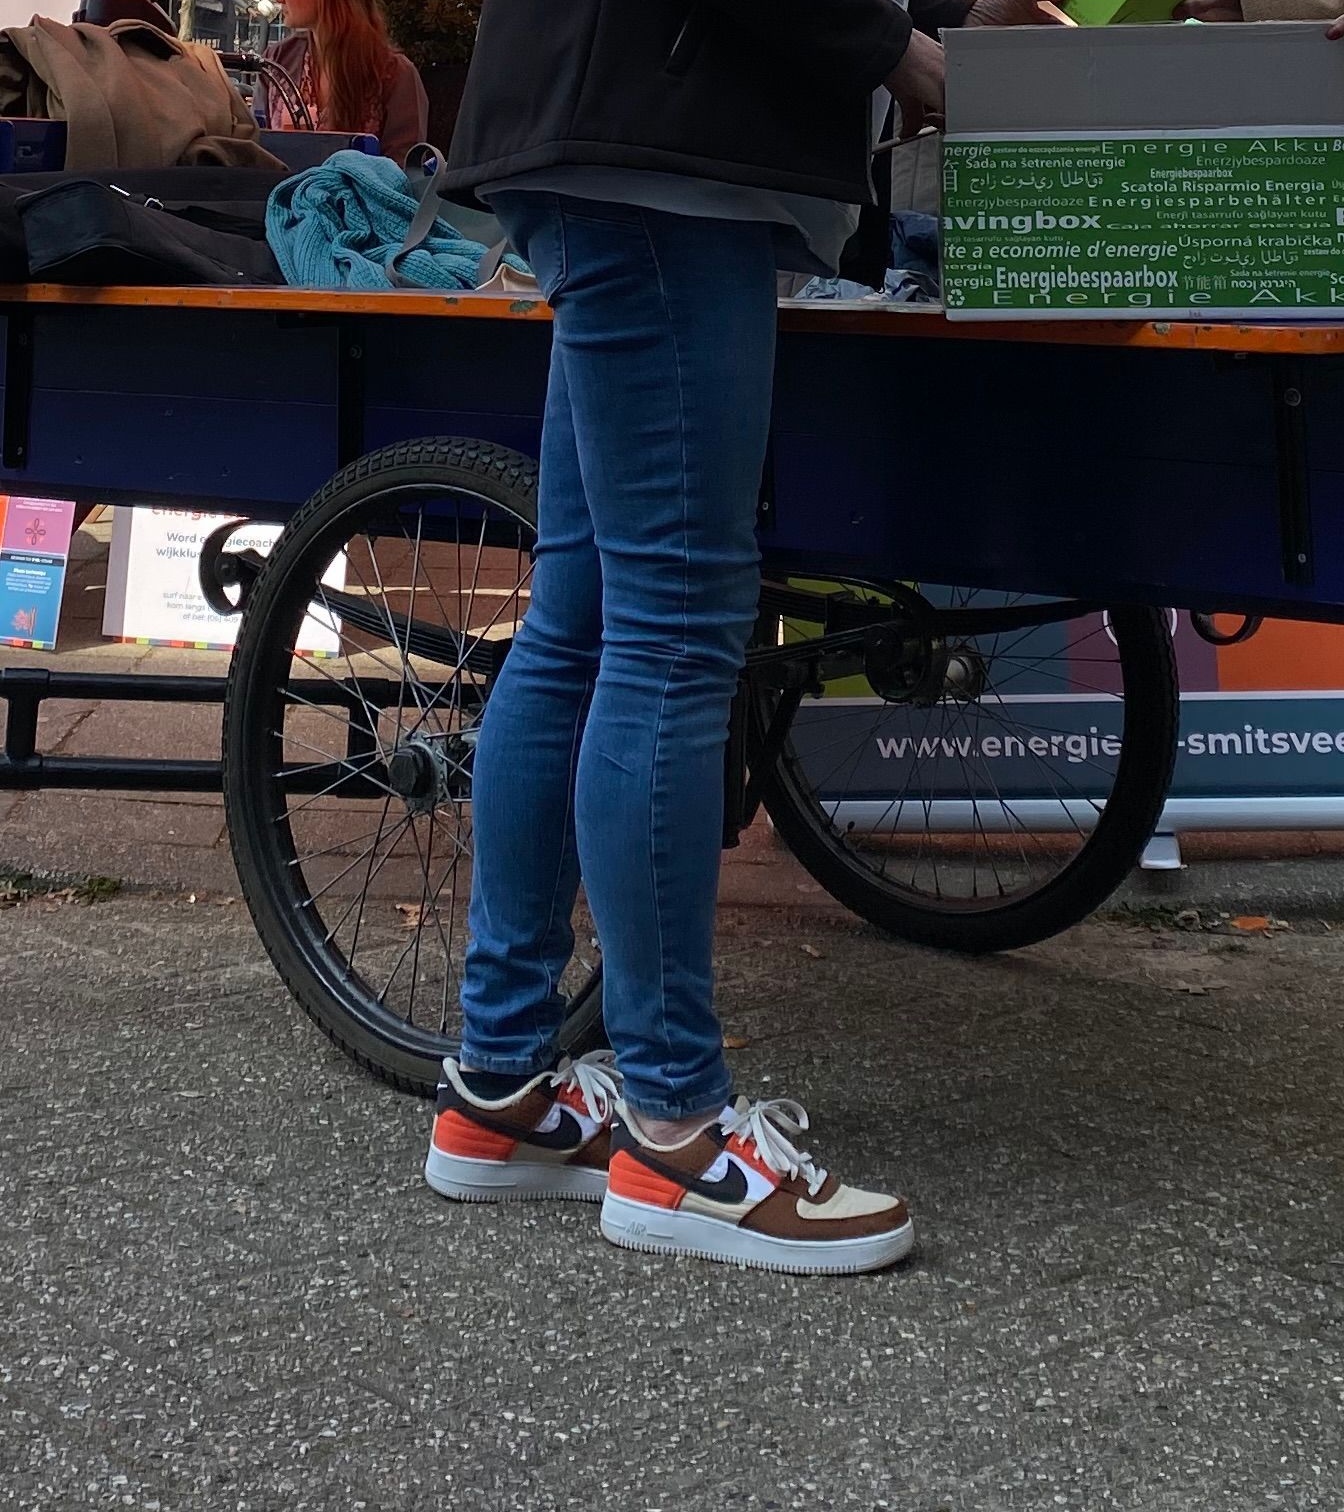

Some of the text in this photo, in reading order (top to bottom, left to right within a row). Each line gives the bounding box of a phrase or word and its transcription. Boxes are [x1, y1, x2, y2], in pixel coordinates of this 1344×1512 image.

[1102, 139, 1327, 157] Energie Akku
[966, 158, 997, 169] Sada
[1000, 159, 1017, 168] na
[1076, 157, 1126, 170] energie
[1150, 167, 1233, 181] Energiebespaarbox
[1121, 179, 1325, 195] Scatola Risparmio Energia
[1178, 234, 1333, 249] Úsporná krabička
[972, 246, 983, 259] a
[989, 241, 1081, 259] economie
[996, 264, 1179, 294] Energiebespaarbox
[992, 289, 1212, 308] Energie
[166, 532, 197, 544] Word
